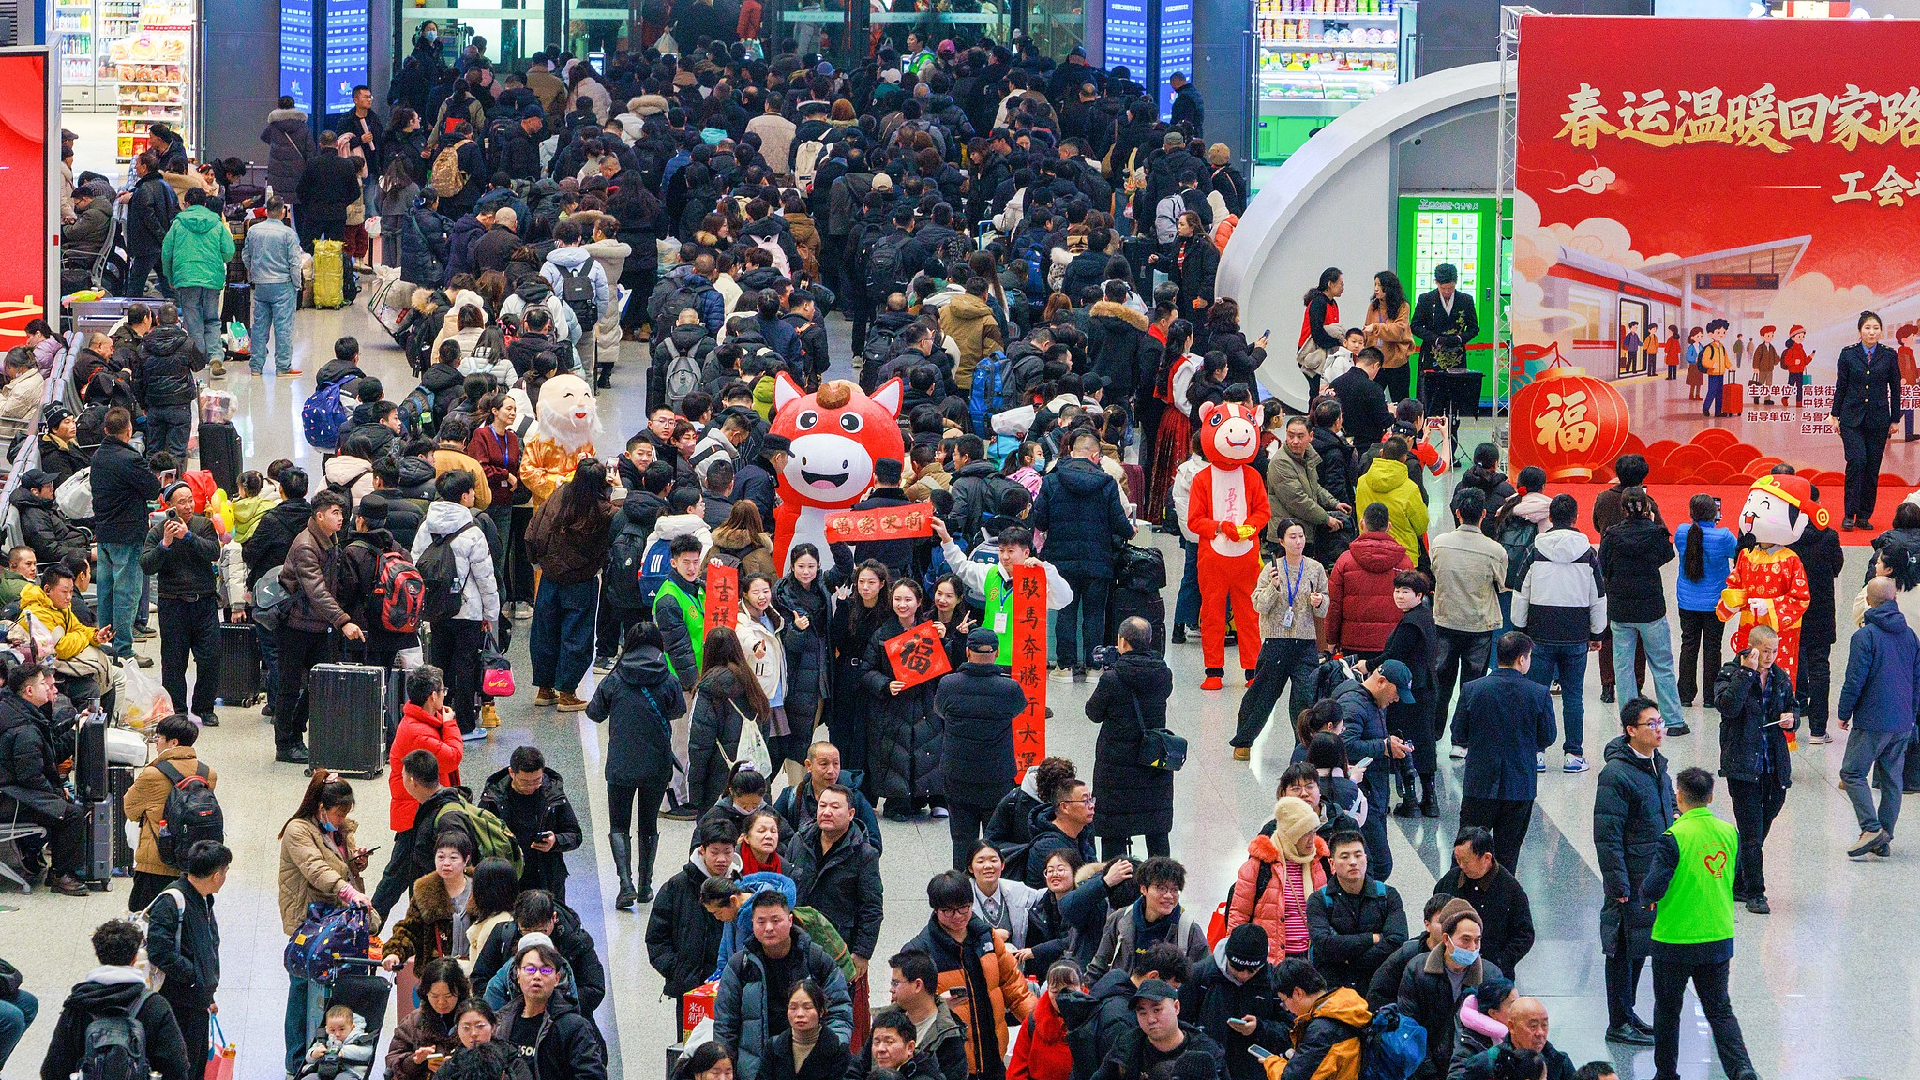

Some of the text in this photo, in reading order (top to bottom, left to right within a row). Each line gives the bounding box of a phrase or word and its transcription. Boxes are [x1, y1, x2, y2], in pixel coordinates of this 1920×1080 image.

[1553, 82, 1920, 153] 春运温暖回家路
[1535, 391, 1597, 454] 福
[712, 577, 733, 626] 吉祥
[900, 634, 933, 675] 福
